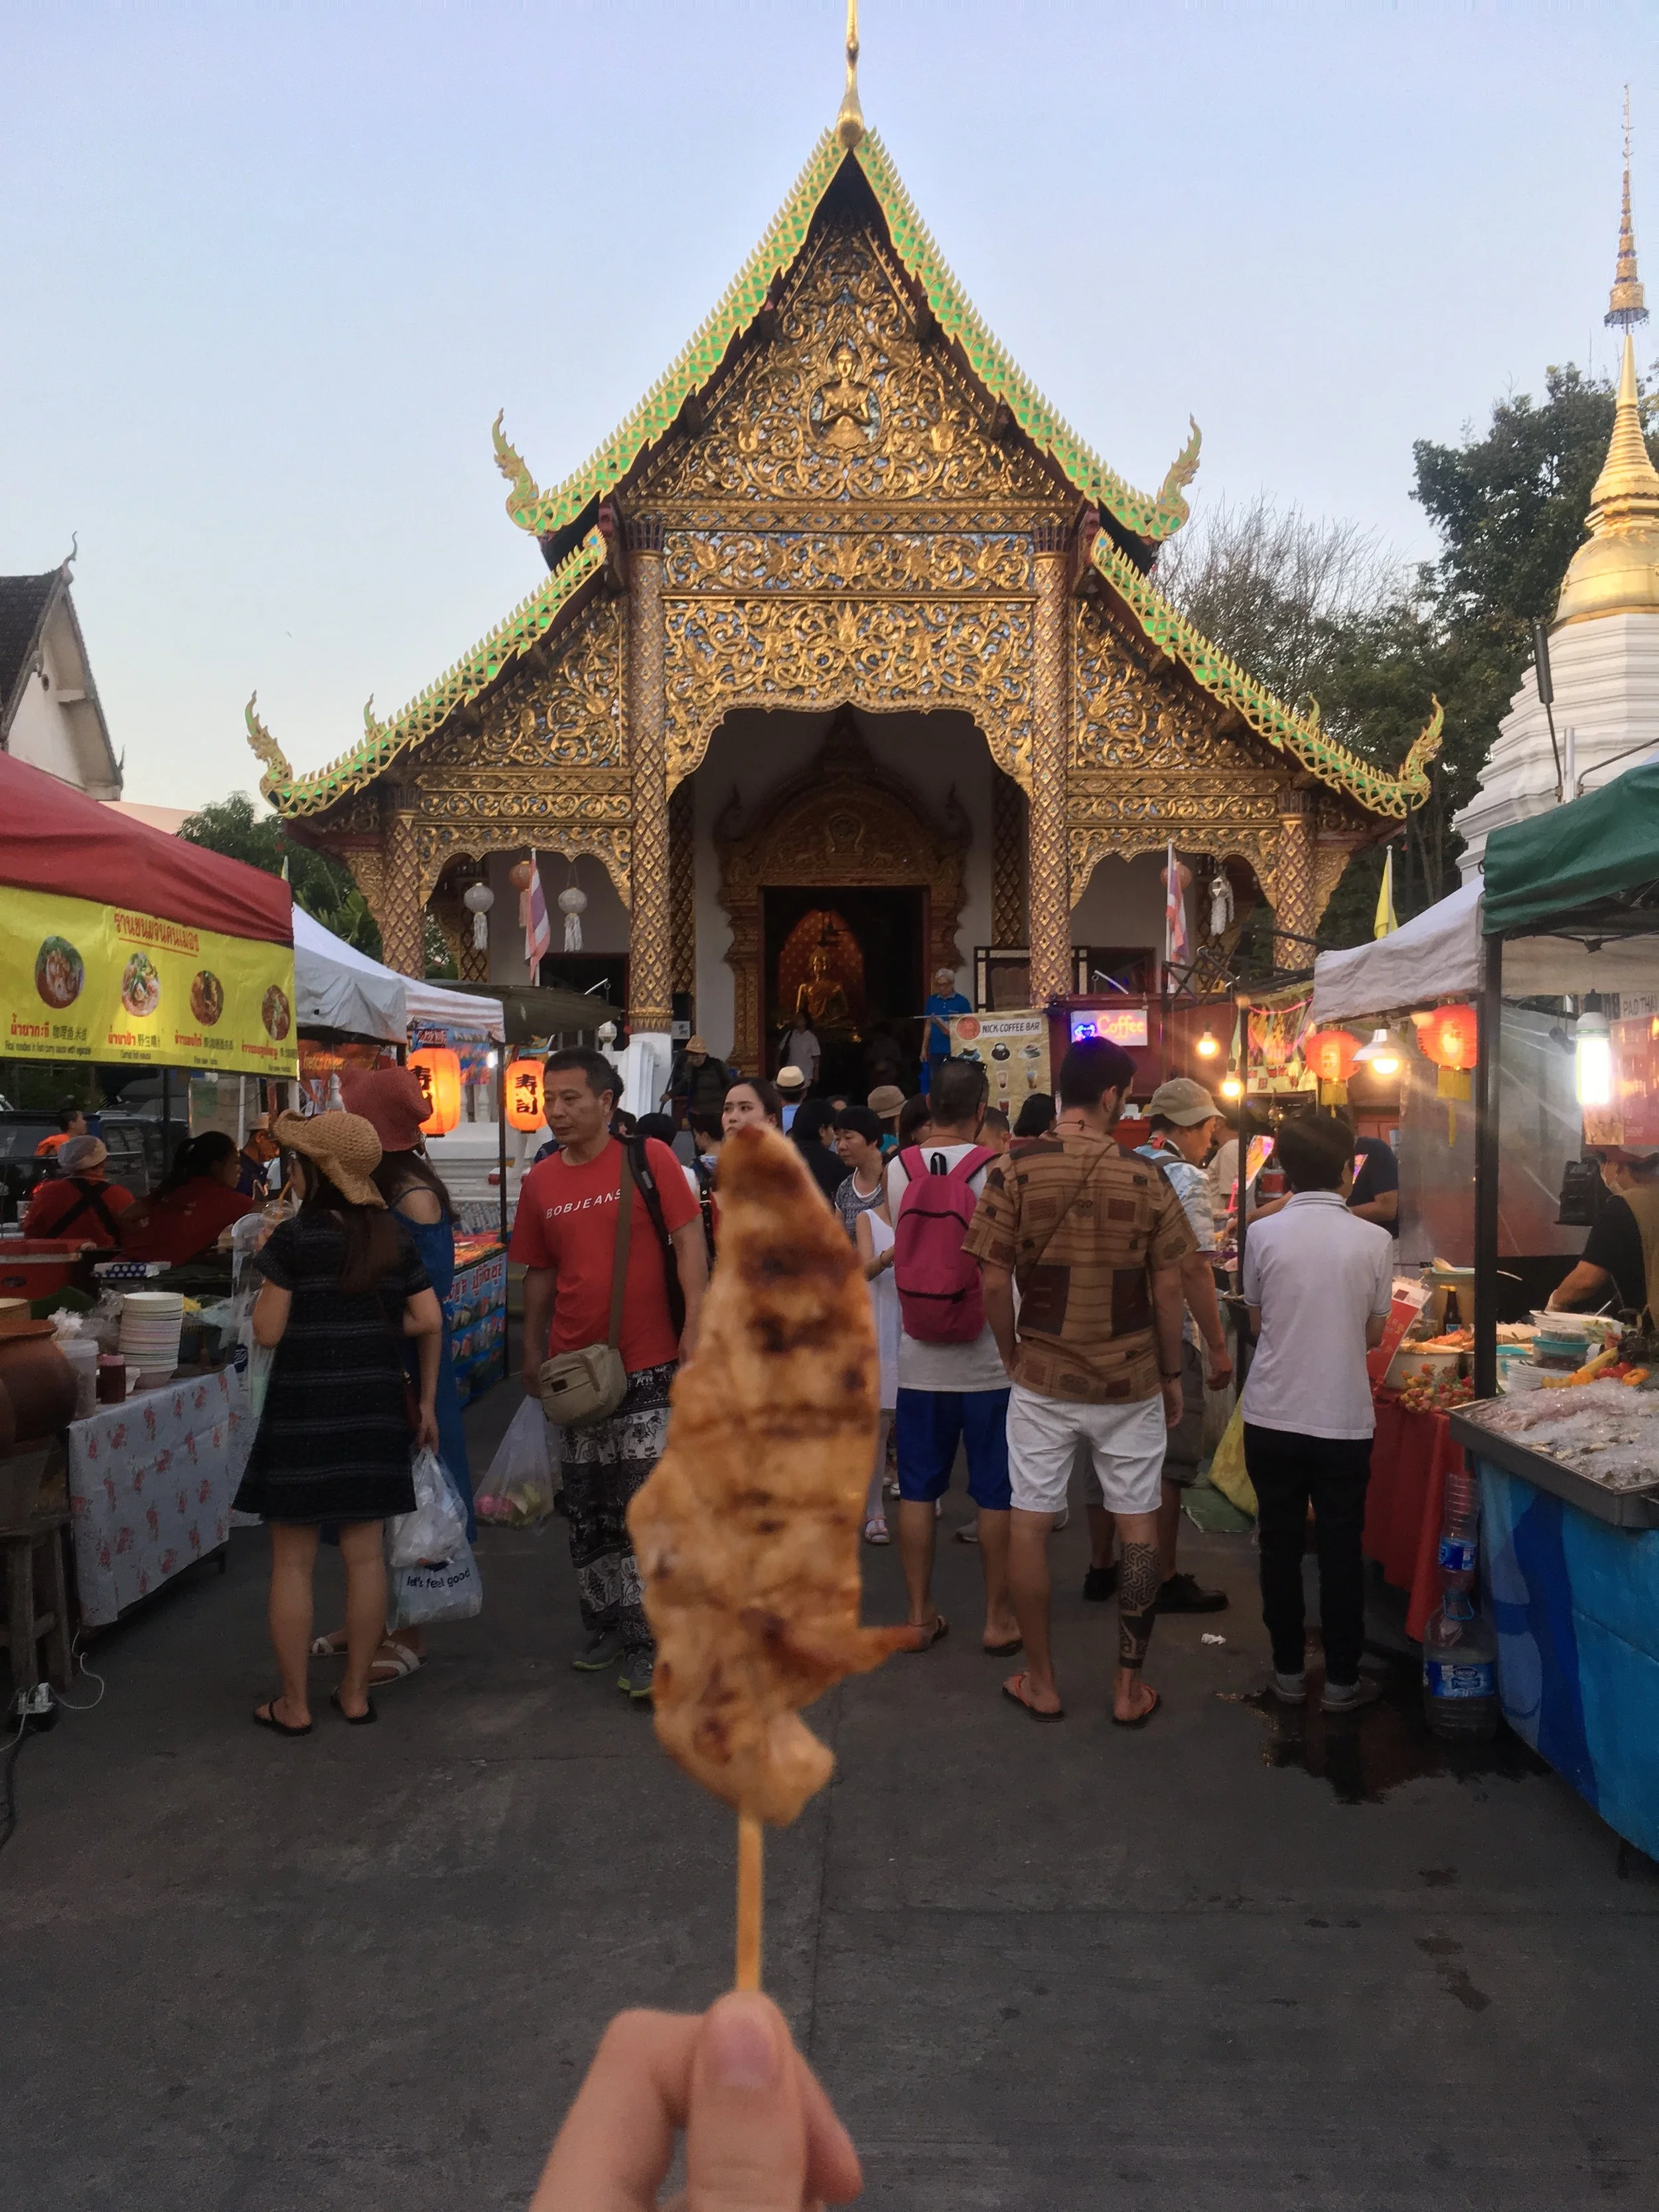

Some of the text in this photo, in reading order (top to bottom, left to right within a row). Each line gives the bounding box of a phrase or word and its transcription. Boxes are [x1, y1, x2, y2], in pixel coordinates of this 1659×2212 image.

[982, 1021, 1040, 1033] NICK COFFEE BAR
[1098, 1015, 1144, 1039] Coffee
[515, 1074, 538, 1115] 寿司
[546, 1189, 621, 1219] BOBJEANS
[407, 1567, 470, 1589] let's feel good
